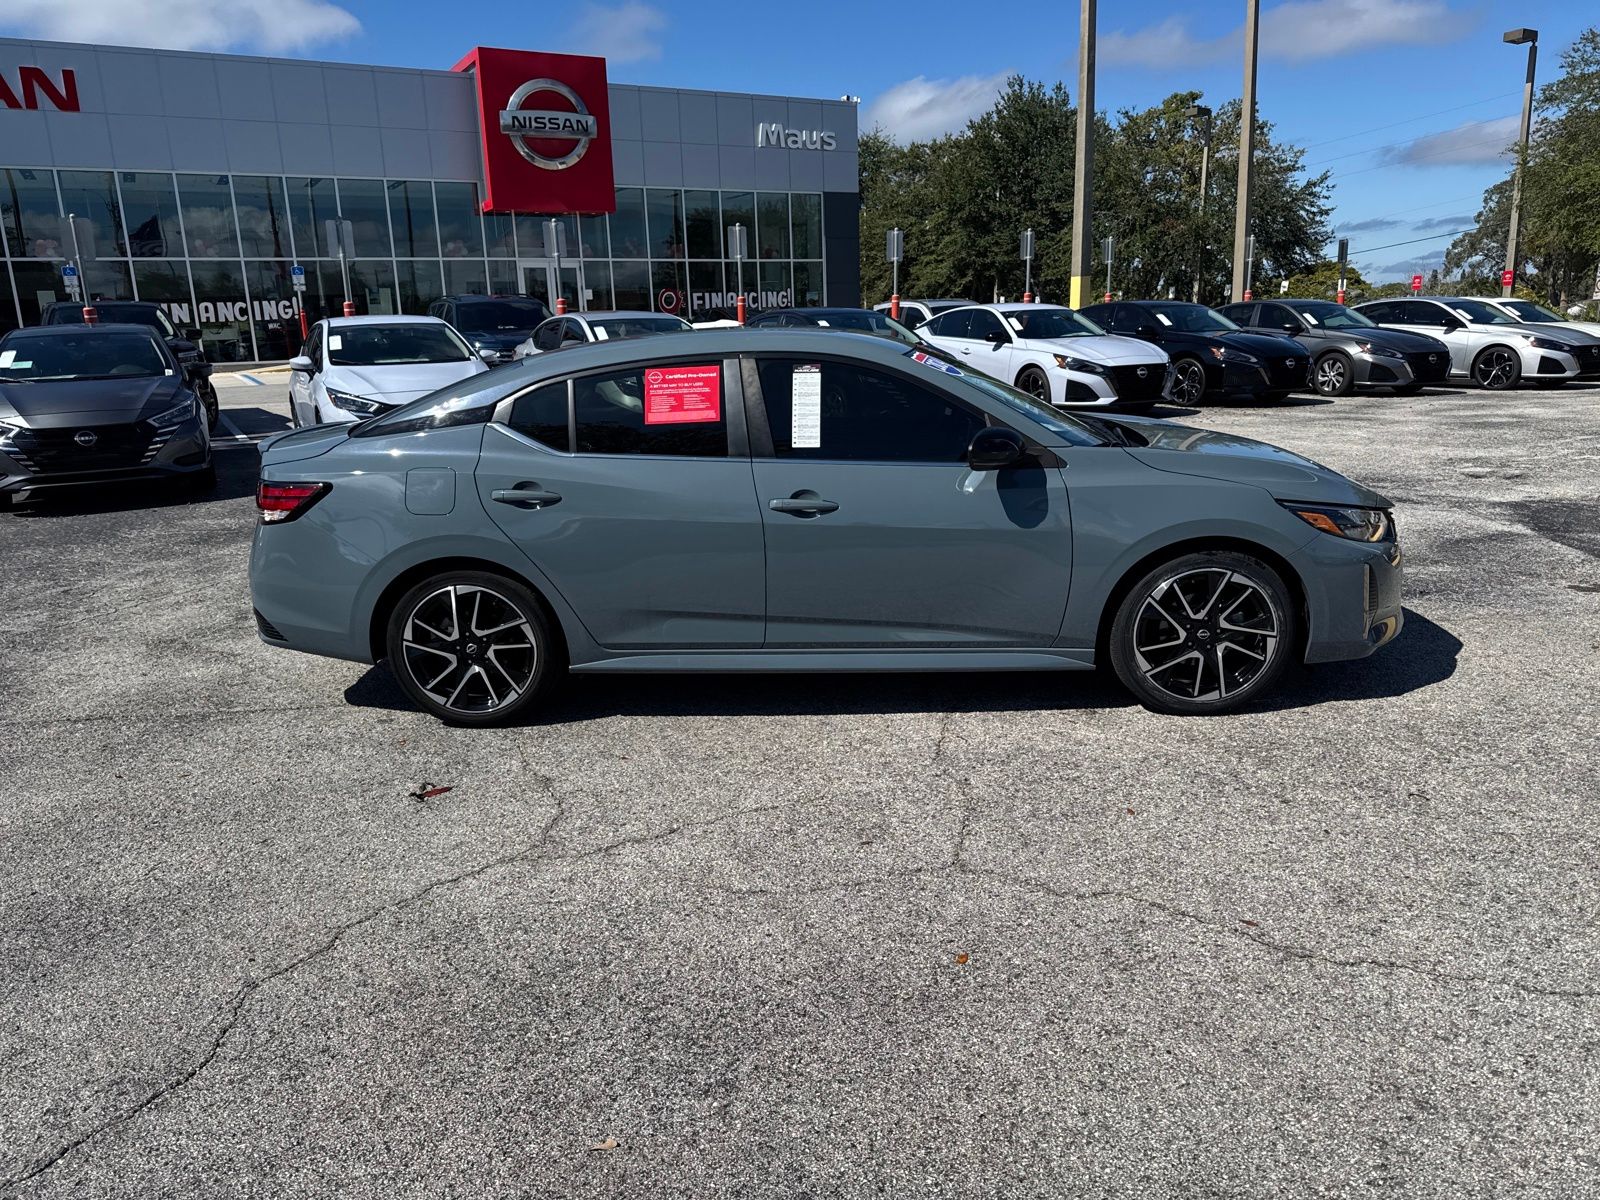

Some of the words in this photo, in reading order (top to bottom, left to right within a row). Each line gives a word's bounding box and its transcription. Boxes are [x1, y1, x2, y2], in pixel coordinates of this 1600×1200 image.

[511, 115, 589, 133] NISSAN
[758, 122, 837, 150] Maus
[692, 288, 791, 310] FINACING!
